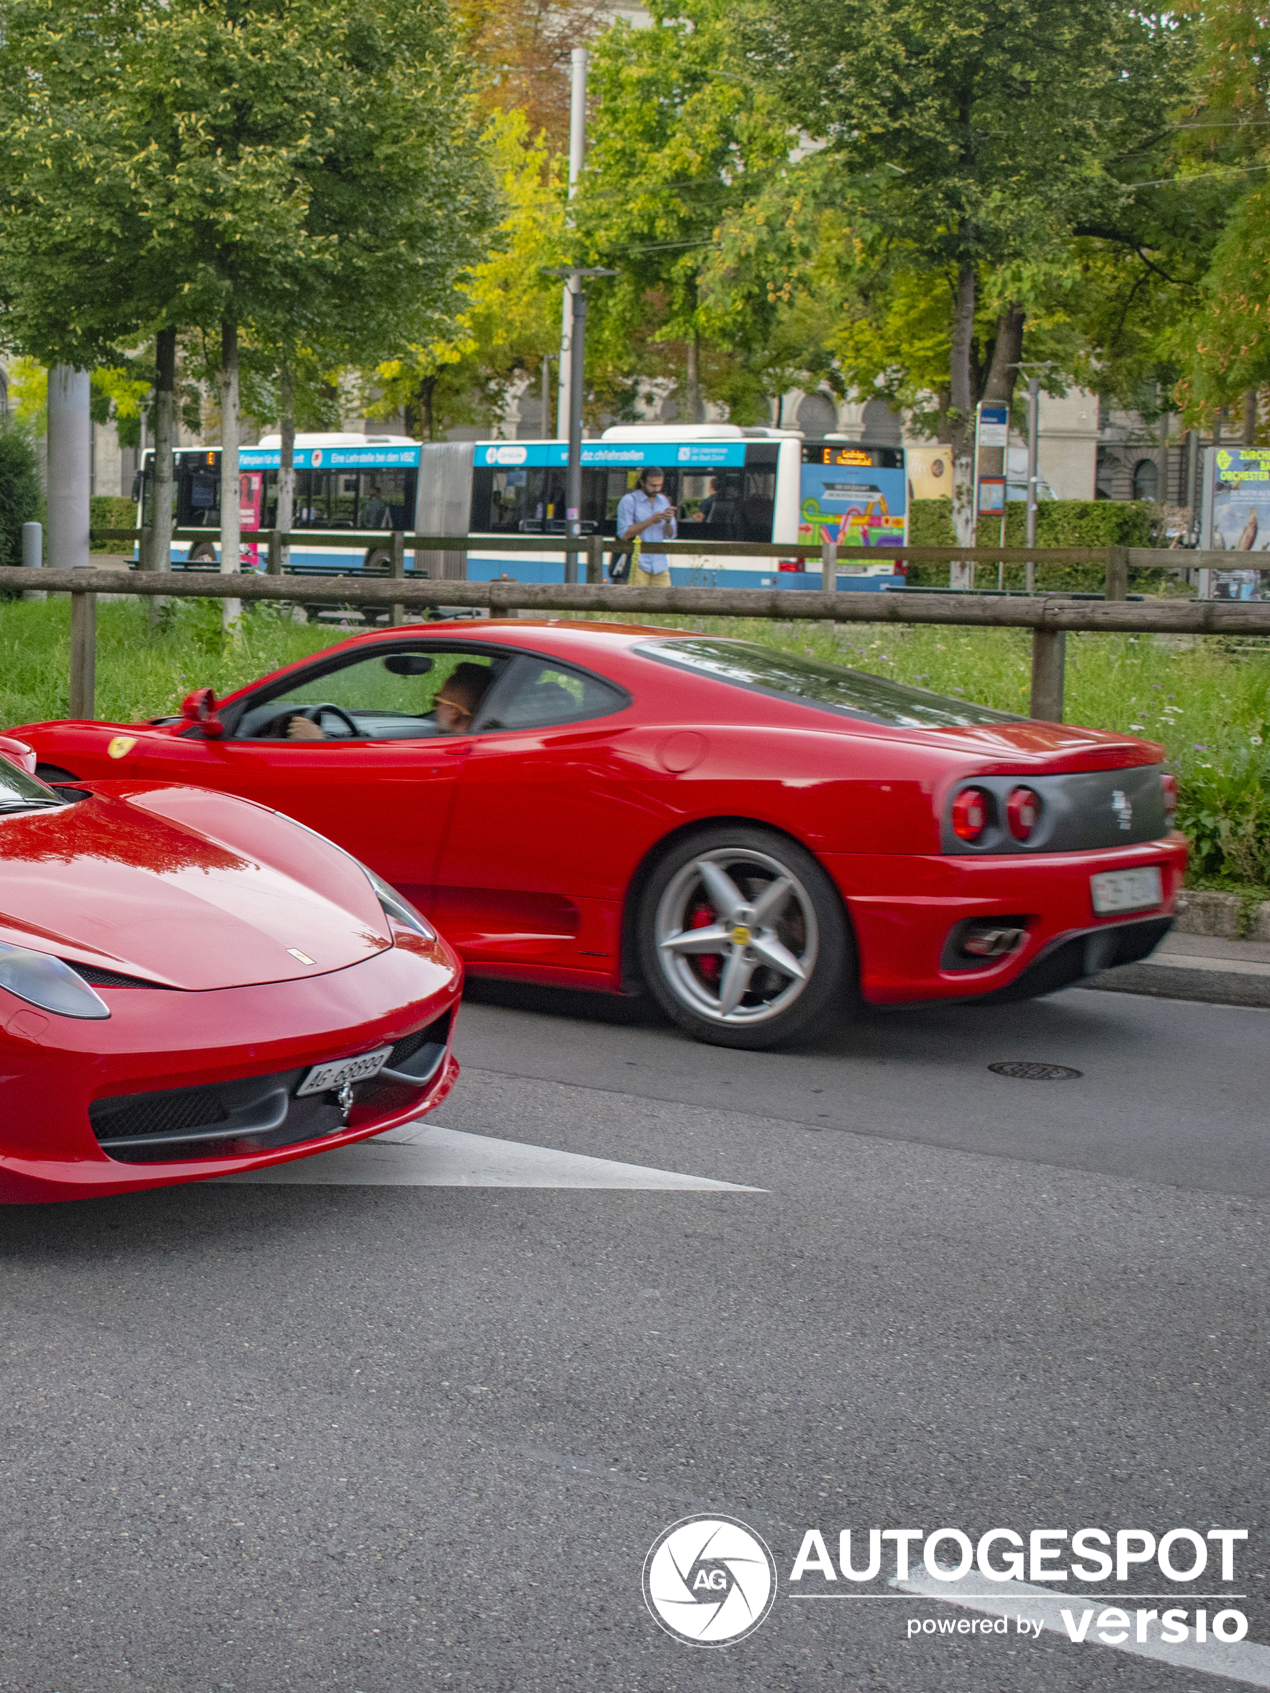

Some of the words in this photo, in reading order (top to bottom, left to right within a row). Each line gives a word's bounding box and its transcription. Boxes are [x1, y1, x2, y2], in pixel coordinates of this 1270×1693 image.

[239, 454, 264, 466] Fahrplan
[331, 453, 345, 463] Eine
[345, 452, 375, 463] Lehrstelle
[375, 452, 386, 463] bei
[386, 452, 399, 462] den
[400, 451, 416, 462] VBZ
[1220, 471, 1269, 481] ORCHESTER
